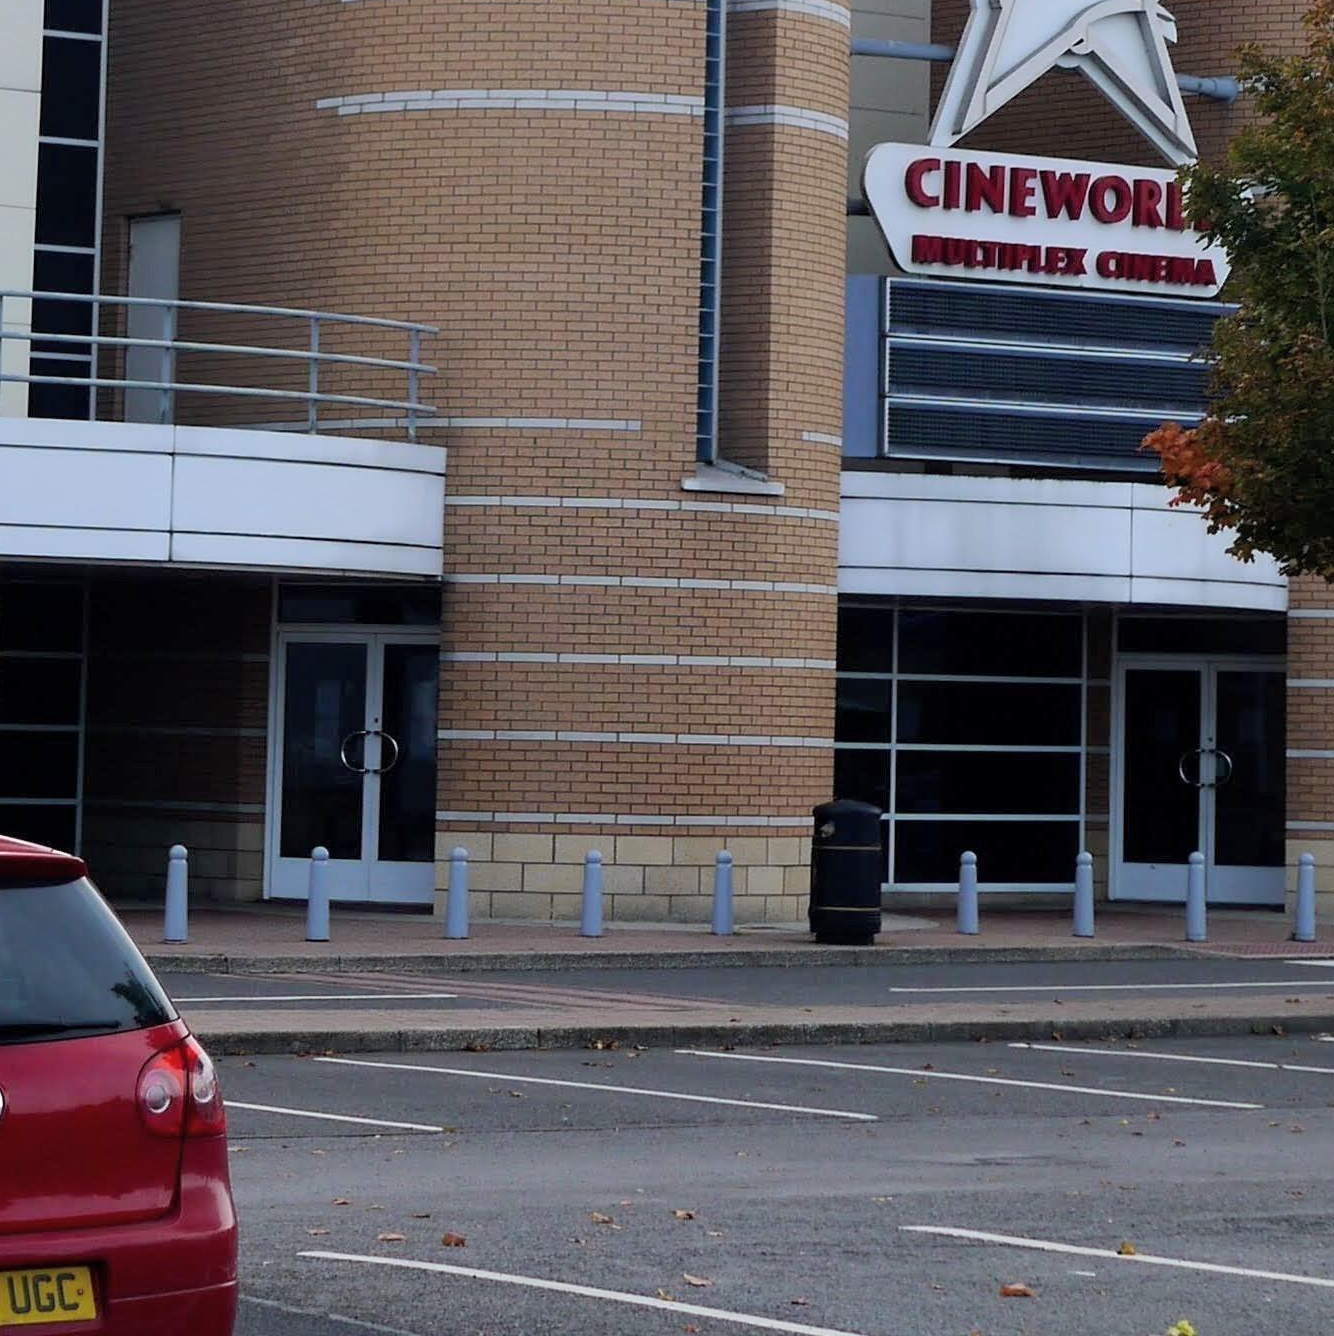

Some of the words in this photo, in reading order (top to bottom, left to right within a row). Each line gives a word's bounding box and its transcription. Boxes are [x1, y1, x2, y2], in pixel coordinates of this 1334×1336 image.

[904, 157, 1214, 232] CINEWORL
[911, 234, 1089, 276] MULTIPLEX
[1095, 250, 1217, 286] CINEMA
[7, 1272, 80, 1315] UGC
